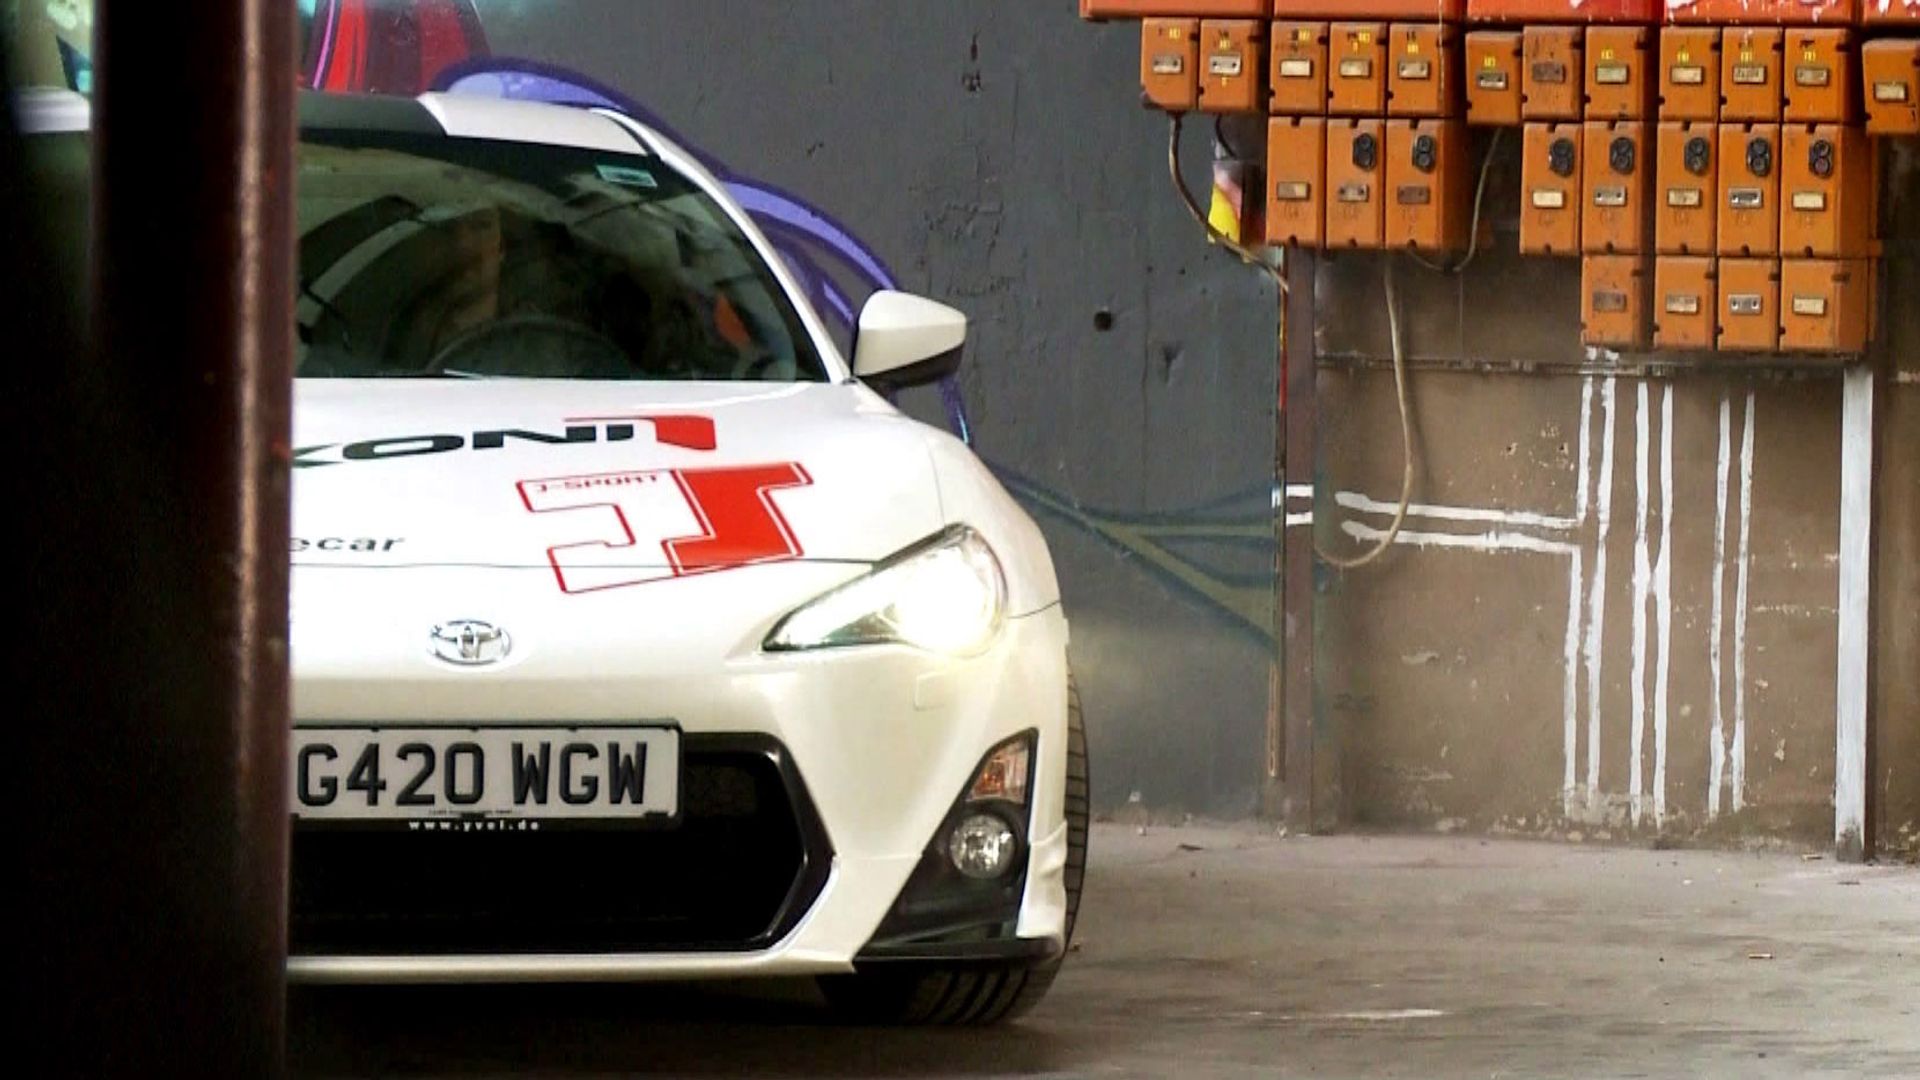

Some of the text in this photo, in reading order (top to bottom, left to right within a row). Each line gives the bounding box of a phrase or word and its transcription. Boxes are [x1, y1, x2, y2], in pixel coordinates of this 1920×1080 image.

[537, 473, 659, 493] J-SPORT
[297, 741, 648, 806] G420 WGW
